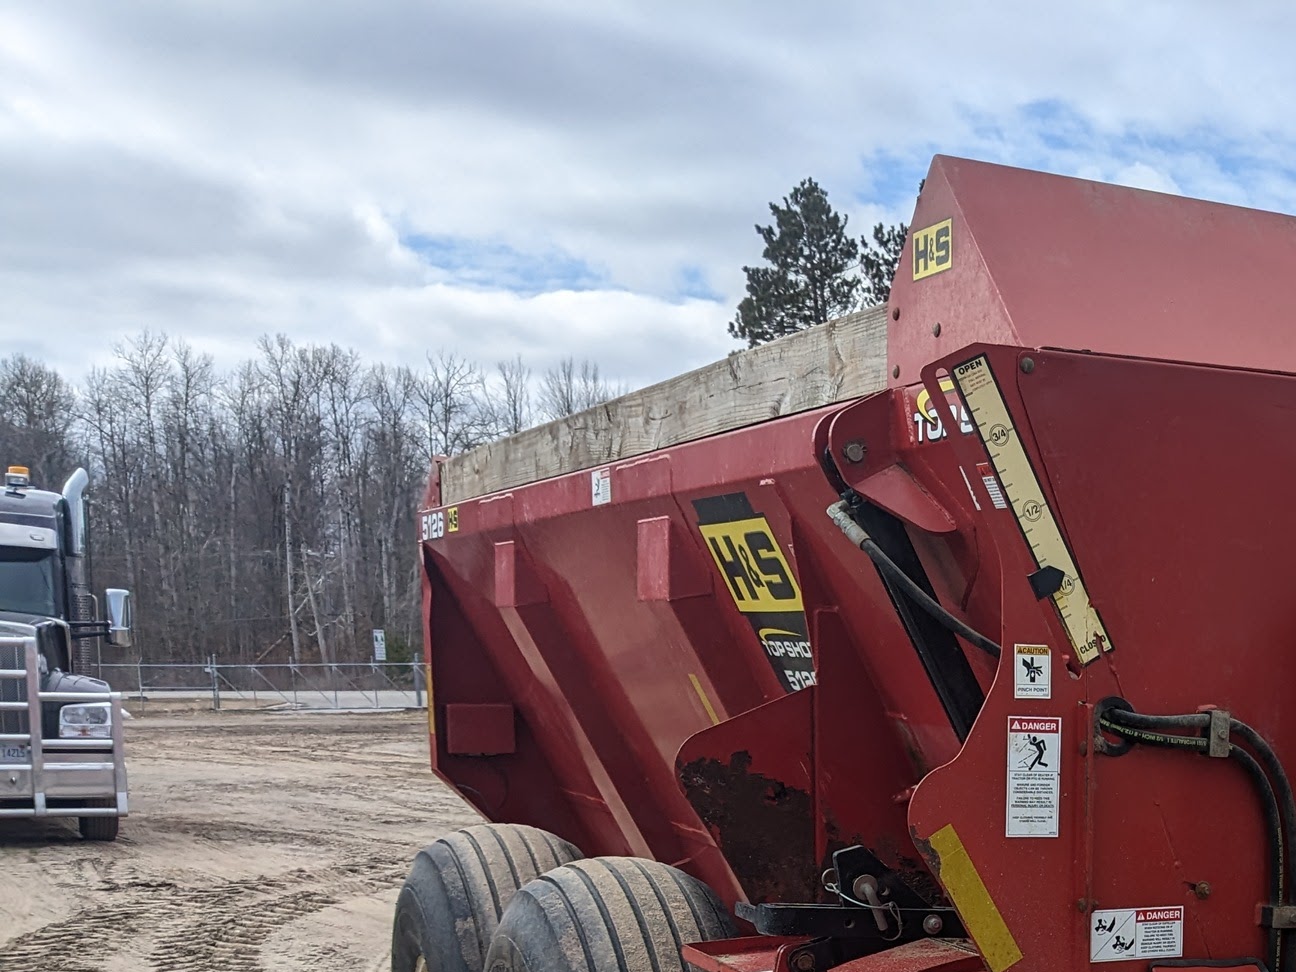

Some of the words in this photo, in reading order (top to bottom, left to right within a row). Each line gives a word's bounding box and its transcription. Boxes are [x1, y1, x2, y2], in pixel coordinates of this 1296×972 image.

[915, 226, 949, 274] H&S
[958, 359, 983, 375] OPEN
[992, 429, 1006, 442] 3/4
[1026, 505, 1040, 516] 1/2
[422, 511, 444, 540] 5126
[708, 530, 796, 600] H&S
[762, 640, 785, 657] TOP
[1022, 647, 1048, 655] CAUTION
[1080, 634, 1107, 655] CLOSD
[1021, 722, 1057, 731] DANGER
[1146, 910, 1180, 920] DANGER
